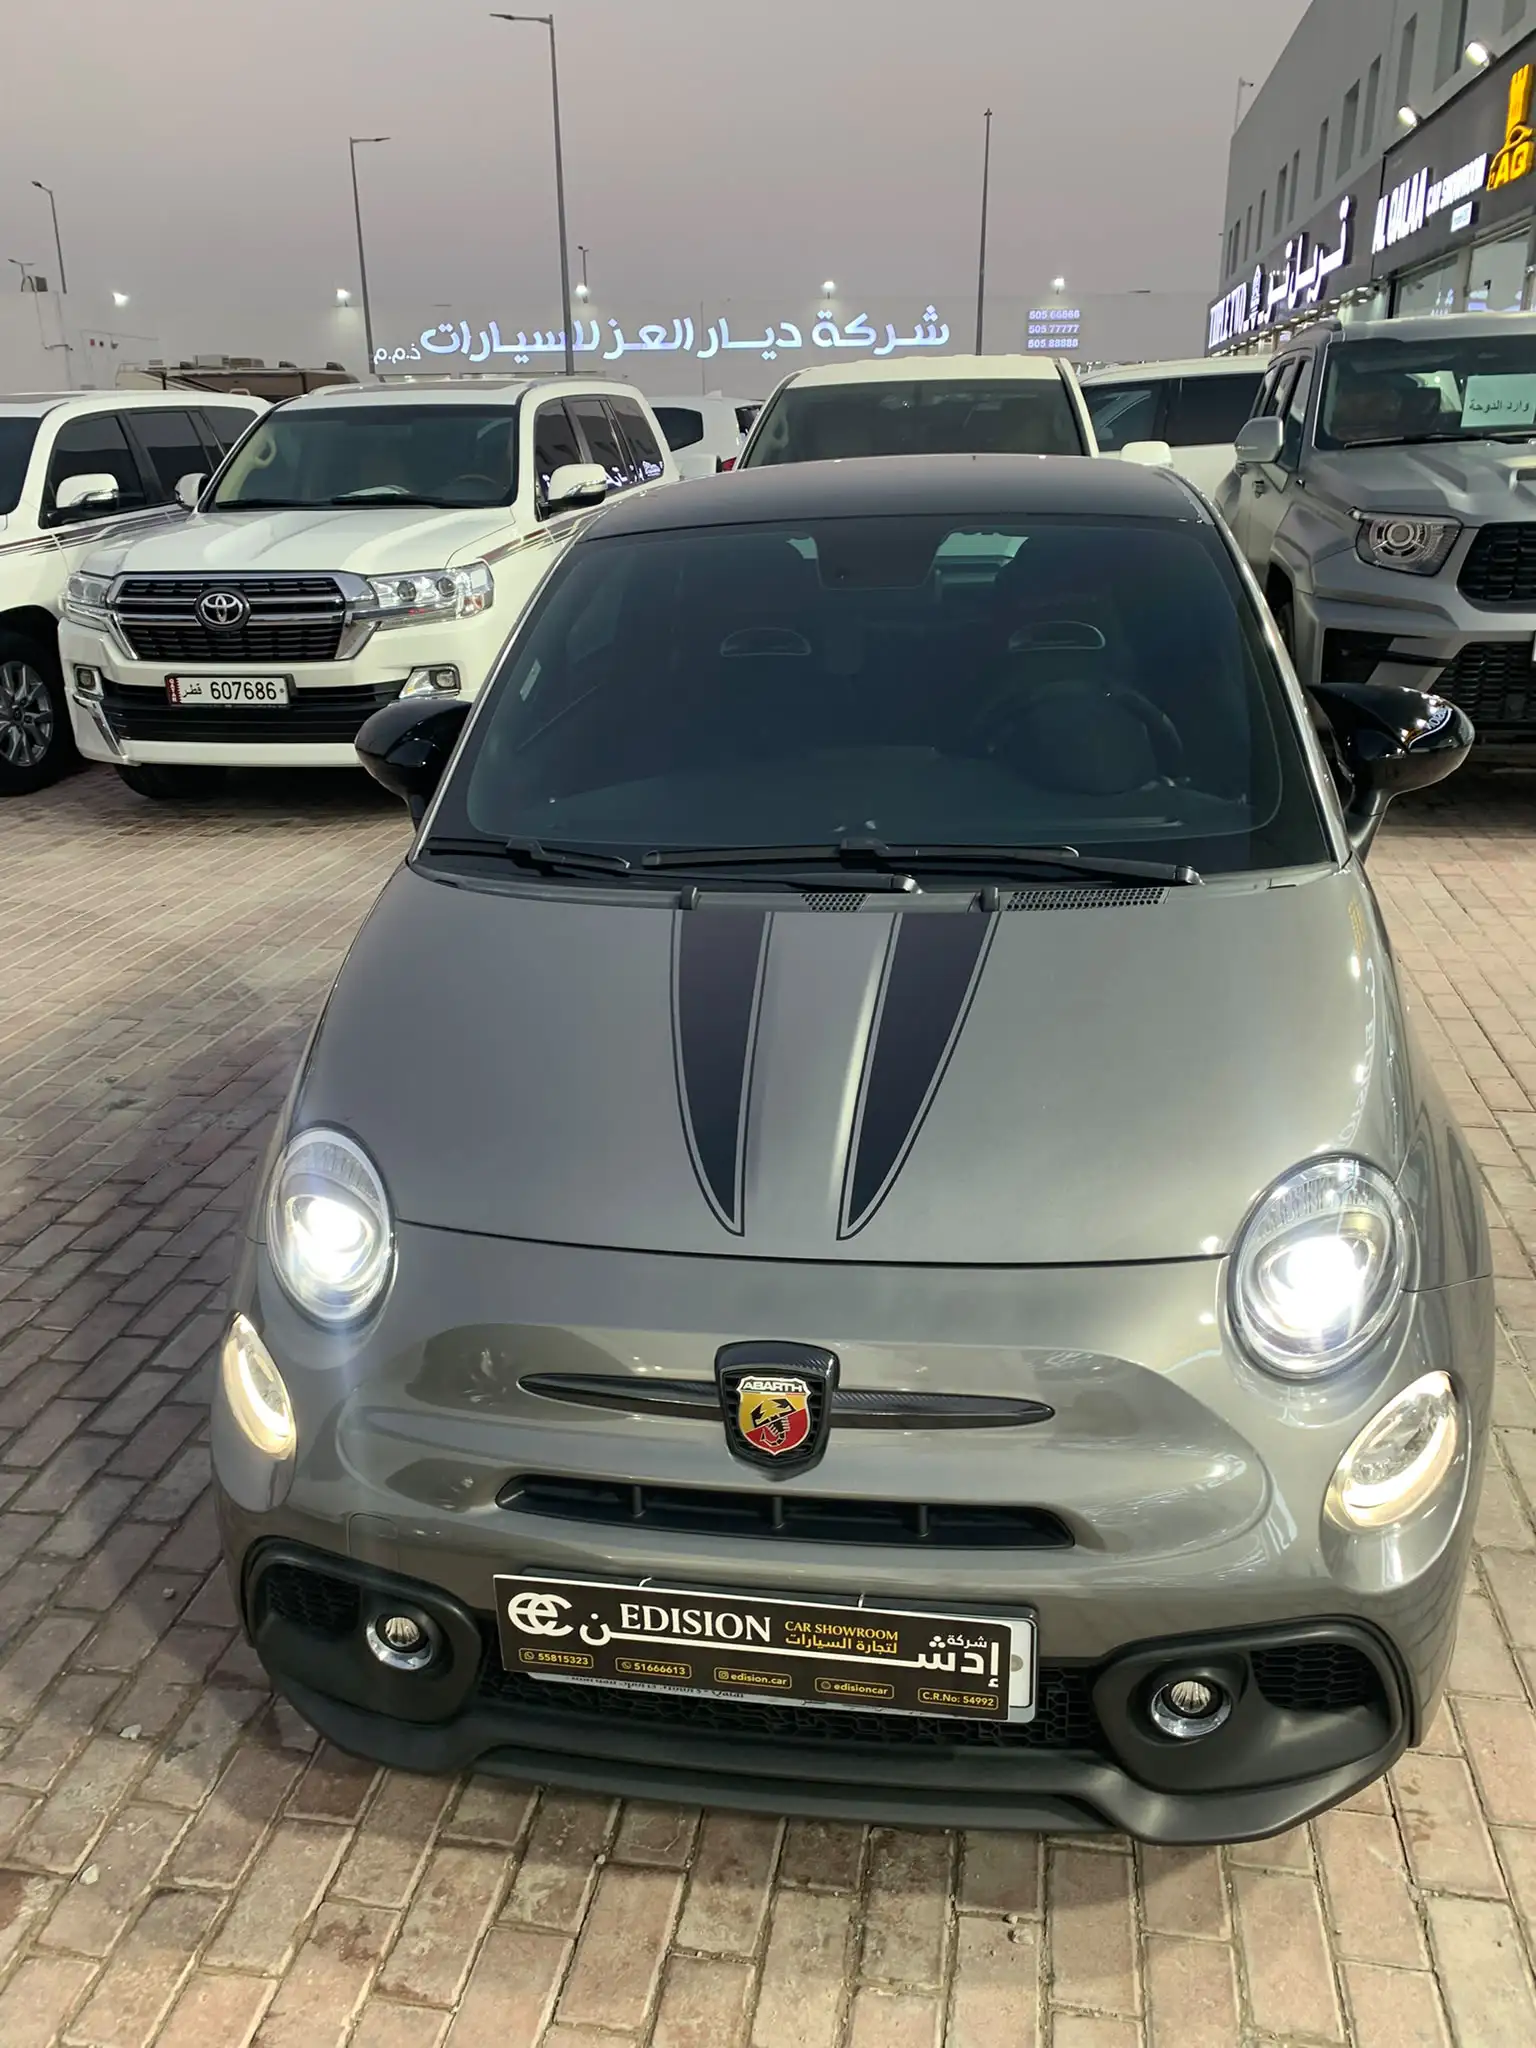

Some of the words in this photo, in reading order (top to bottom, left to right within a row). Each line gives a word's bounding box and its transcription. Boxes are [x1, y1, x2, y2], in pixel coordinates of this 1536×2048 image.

[812, 304, 949, 355] شركة
[420, 319, 601, 364] للسيارات
[602, 316, 694, 360] العز
[697, 317, 803, 360] ديار
[182, 683, 203, 698] قطر
[210, 681, 277, 700] 607686
[743, 1382, 803, 1392] ABARTH
[620, 1603, 771, 1643] EDISION
[785, 1621, 811, 1633] CAR
[815, 1623, 898, 1641] SHOWROOM
[785, 1633, 852, 1649] السيارات
[856, 1640, 897, 1655] لتجارة
[947, 1634, 987, 1649] شركة
[538, 1652, 589, 1665] 55815323
[634, 1663, 686, 1676] 51666613
[731, 1673, 787, 1686] edision.car
[833, 1683, 888, 1695] edisioncar
[922, 1691, 960, 1704] C.R.No:
[963, 1695, 994, 1707] 54992
